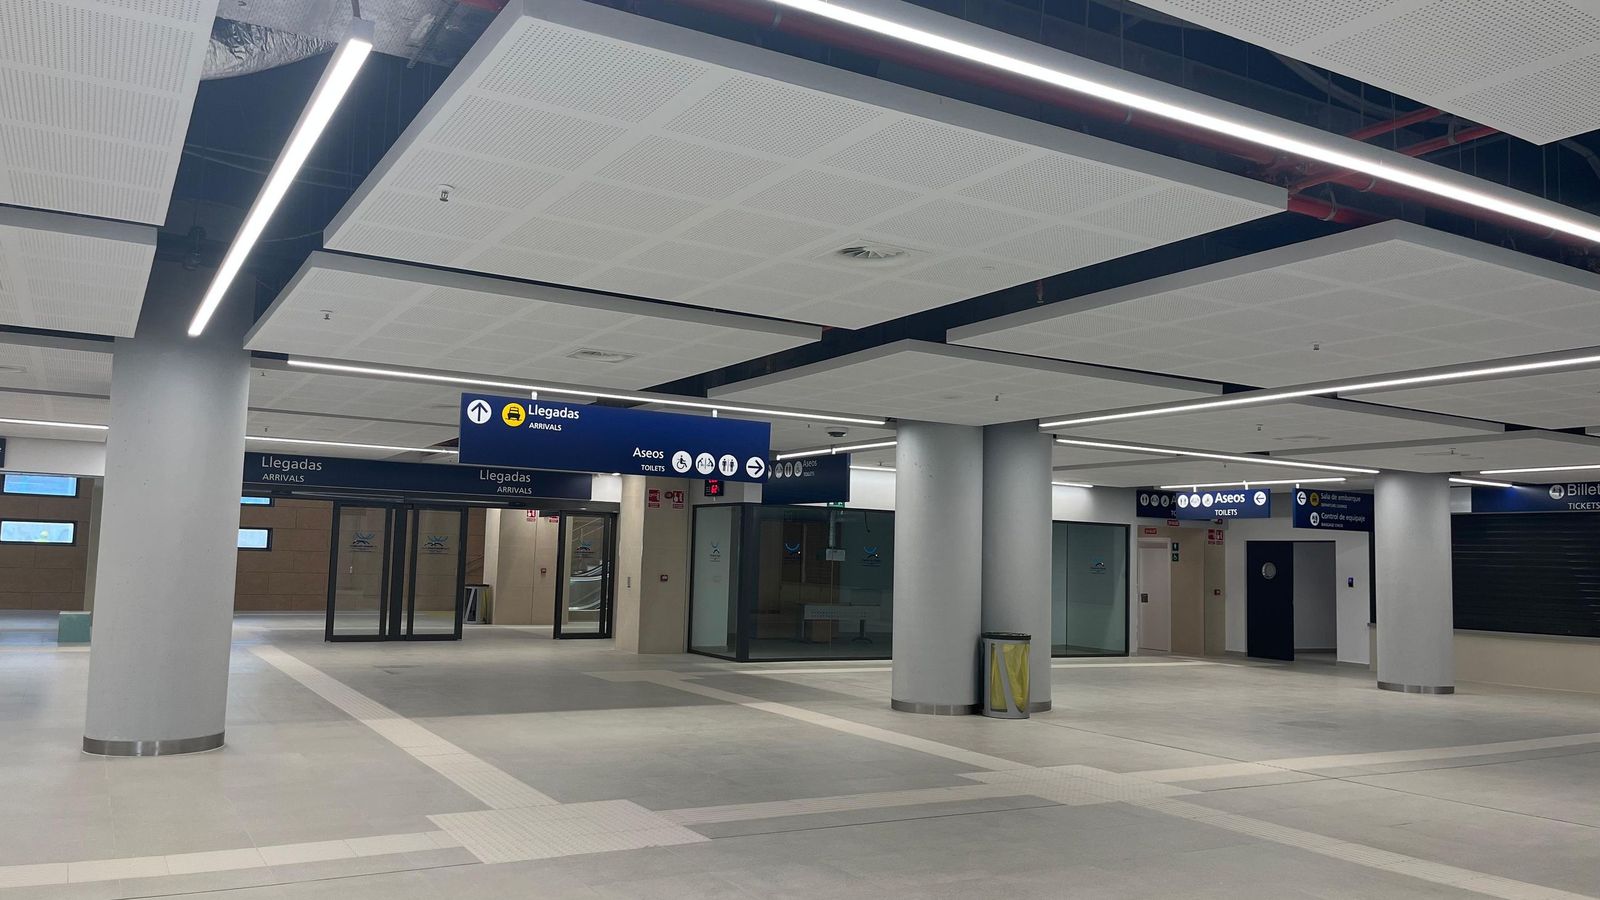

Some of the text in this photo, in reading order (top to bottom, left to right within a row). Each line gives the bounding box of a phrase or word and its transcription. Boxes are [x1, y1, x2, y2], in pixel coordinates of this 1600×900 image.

[528, 404, 579, 420] Llegadas
[529, 422, 562, 431] ARRIVALS
[632, 447, 664, 460] Aseos
[262, 456, 322, 472] Llegadas
[641, 464, 665, 472] TOILETS
[262, 473, 305, 483] ARRIVALS
[480, 469, 531, 484] Llegadas
[497, 485, 532, 495] ARRIVALS
[1214, 492, 1245, 504] Aseos
[1321, 492, 1331, 500] Sala
[1338, 494, 1361, 503] embarque
[1215, 508, 1238, 517] TOILETS
[1321, 512, 1366, 523] Control de equipaje
